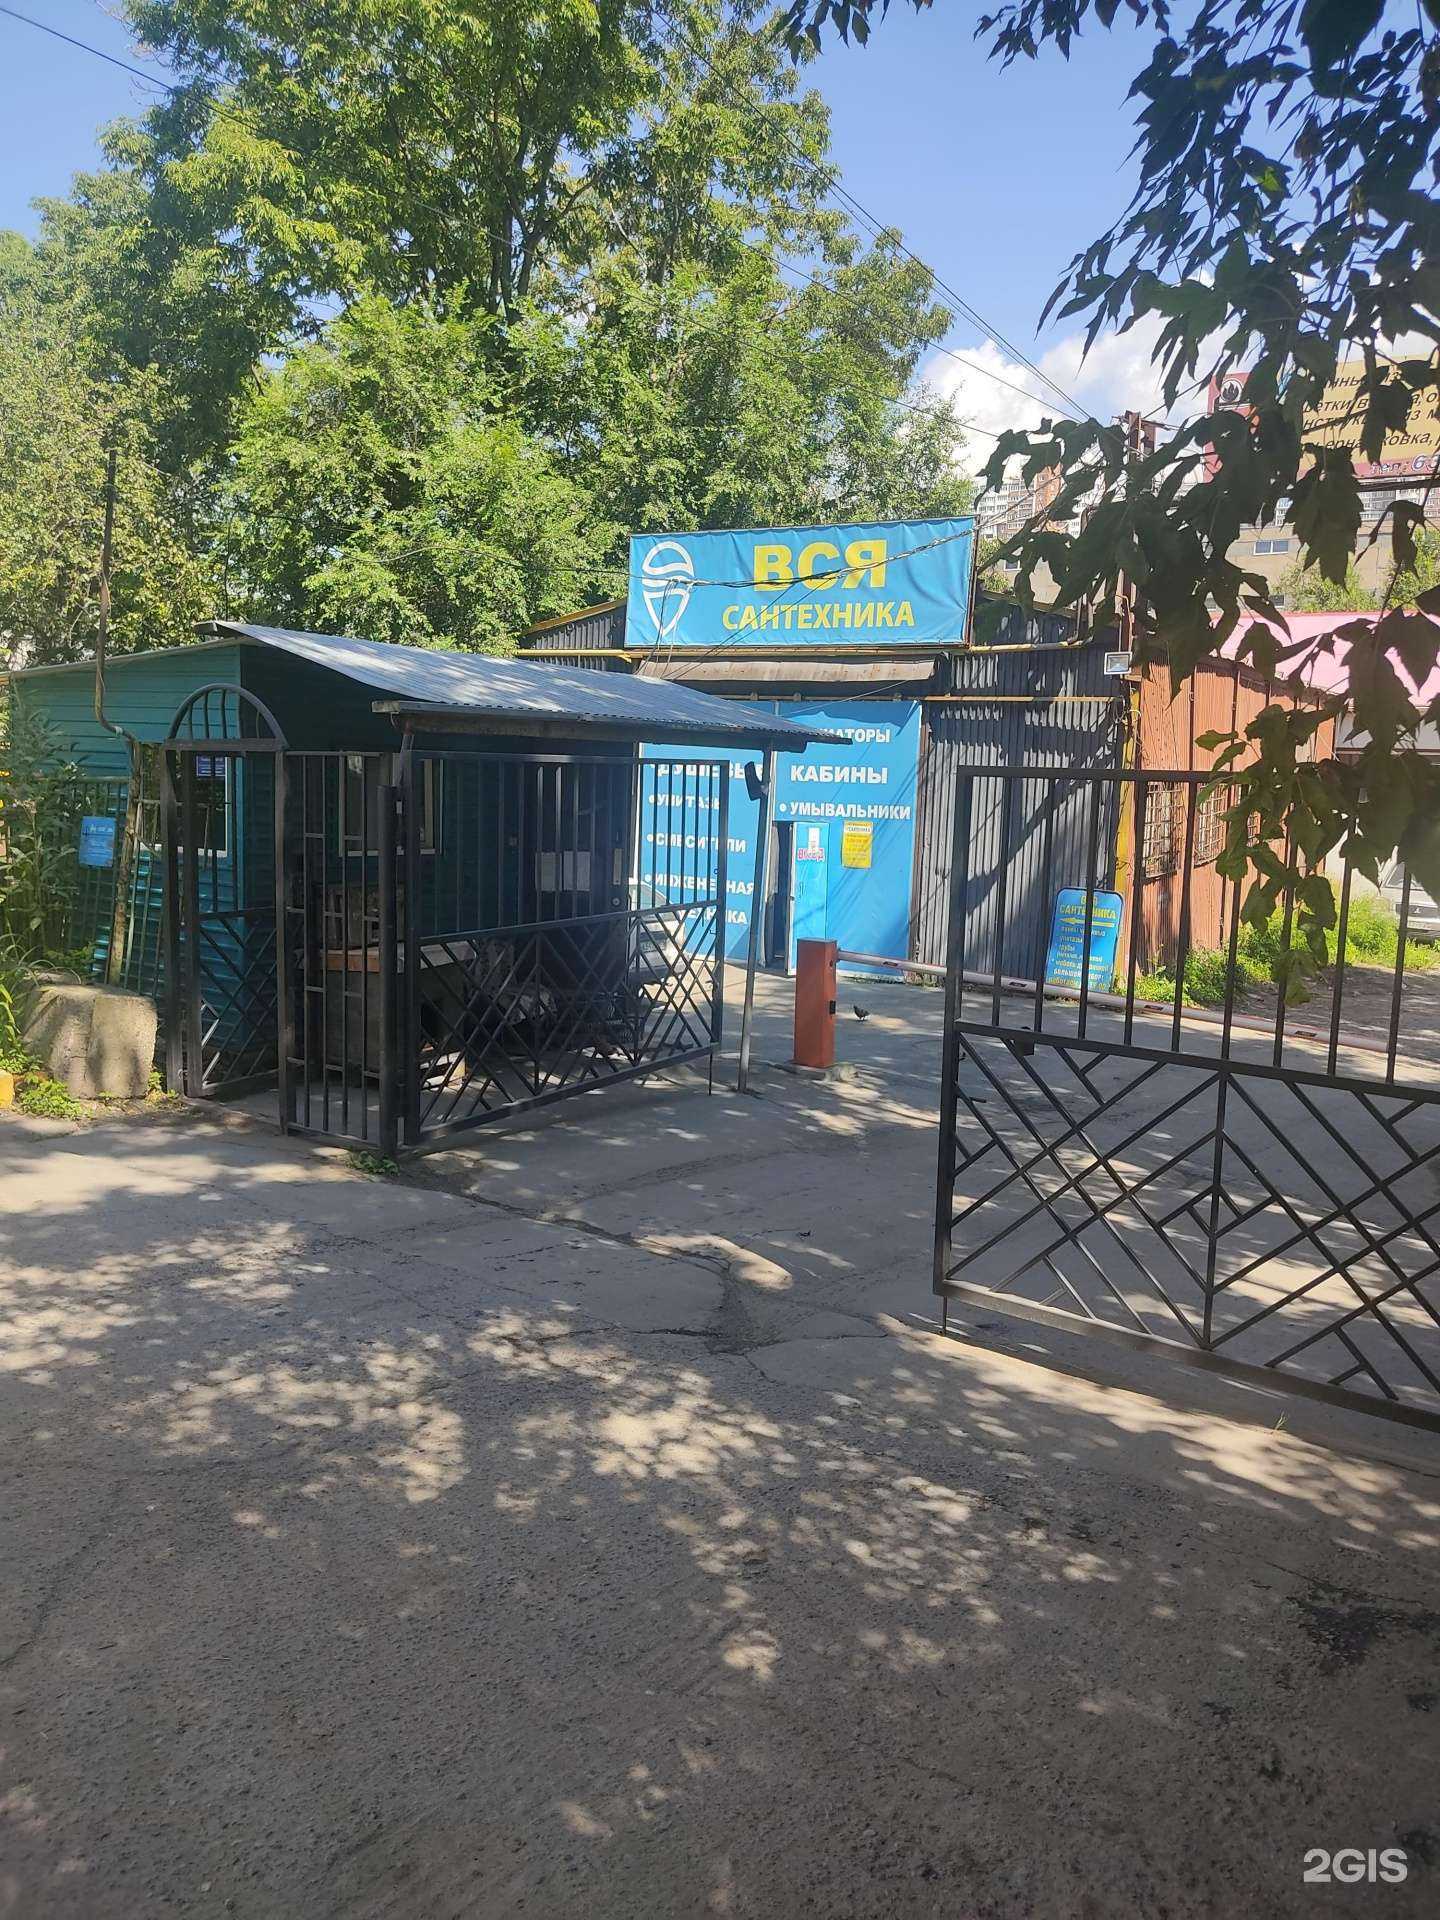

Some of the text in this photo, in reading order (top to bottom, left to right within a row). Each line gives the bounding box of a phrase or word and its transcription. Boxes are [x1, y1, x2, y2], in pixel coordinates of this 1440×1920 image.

[754, 539, 888, 592] ВСЯ
[722, 600, 915, 631] САНТЕХНИКА
[790, 765, 888, 784] КАБИНЫ
[790, 802, 912, 820] УМЫВАЛЬНИКИ
